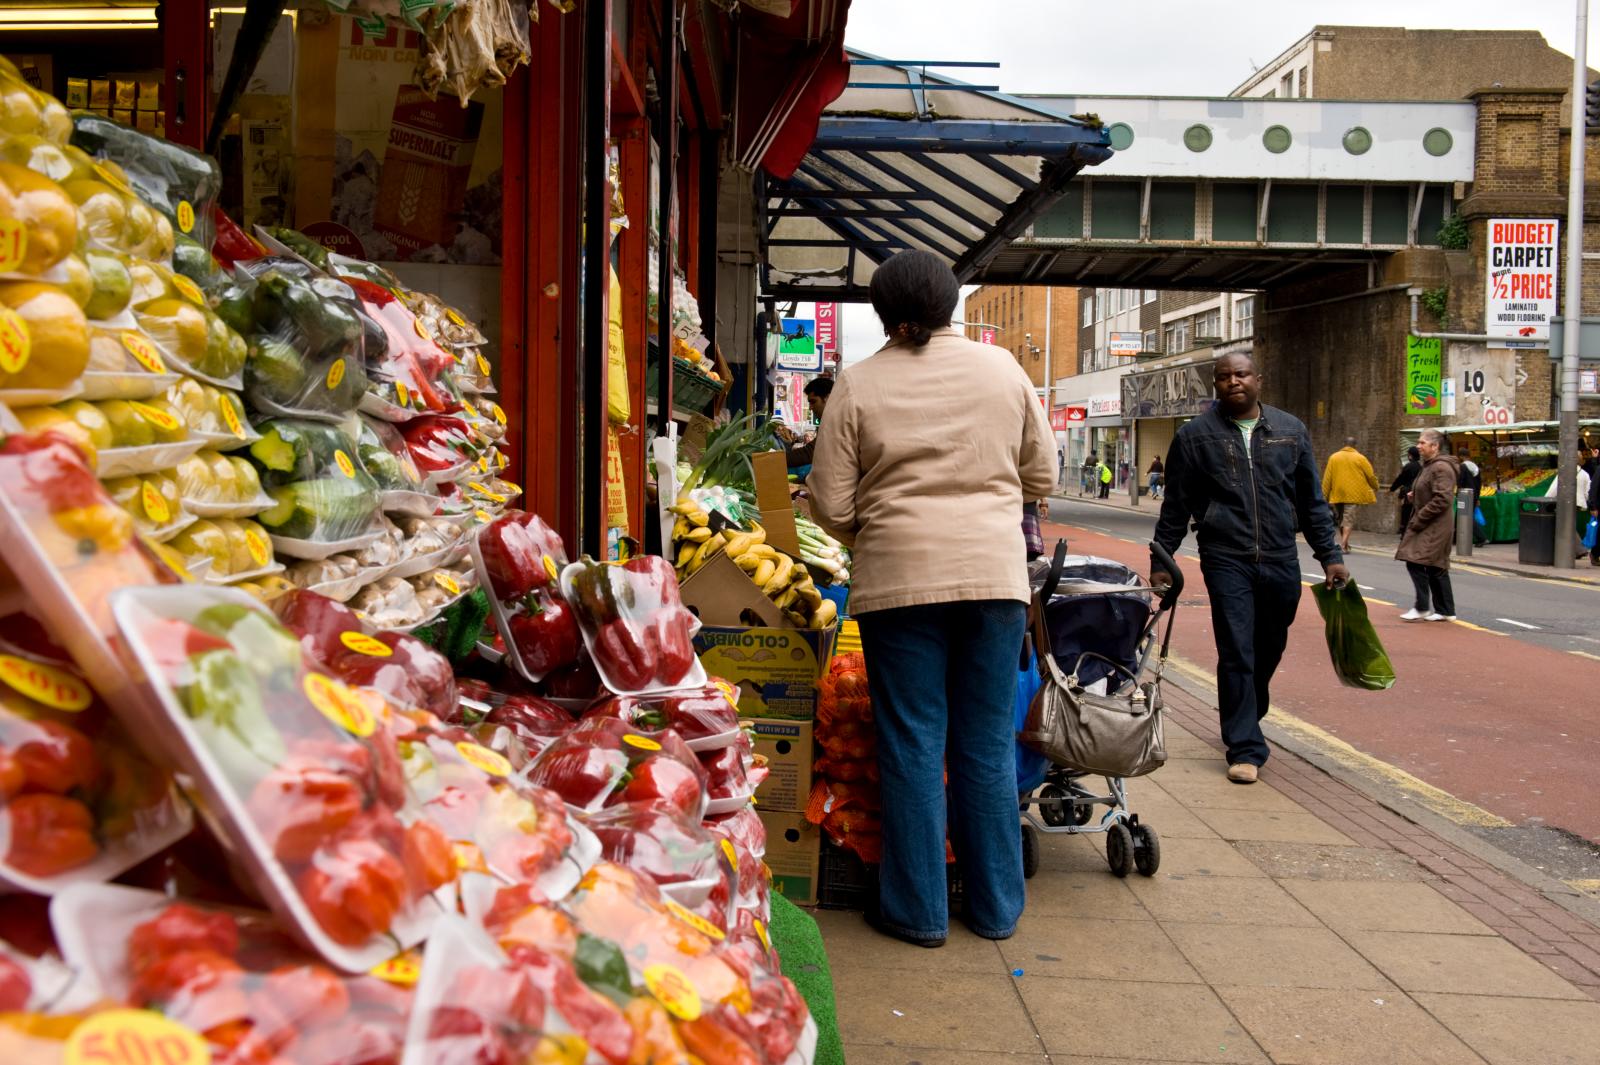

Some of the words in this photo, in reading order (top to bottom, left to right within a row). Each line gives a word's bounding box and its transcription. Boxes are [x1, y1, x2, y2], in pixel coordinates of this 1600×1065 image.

[388, 127, 458, 161] SUPERMALT
[324, 234, 352, 245] COOL
[1493, 223, 1554, 244] BUDGET
[1492, 246, 1553, 268] CARPET
[1511, 273, 1552, 299] PRICE
[1505, 303, 1538, 312] LAMINATED
[1498, 313, 1515, 322] WOOD
[1517, 313, 1546, 322] FLOORING
[1410, 335, 1439, 349] Ali's
[1410, 353, 1440, 369] Fresh
[1410, 370, 1439, 385] Fruit
[756, 724, 797, 736] PREMIUM
[80, 1027, 190, 1065] 50p
